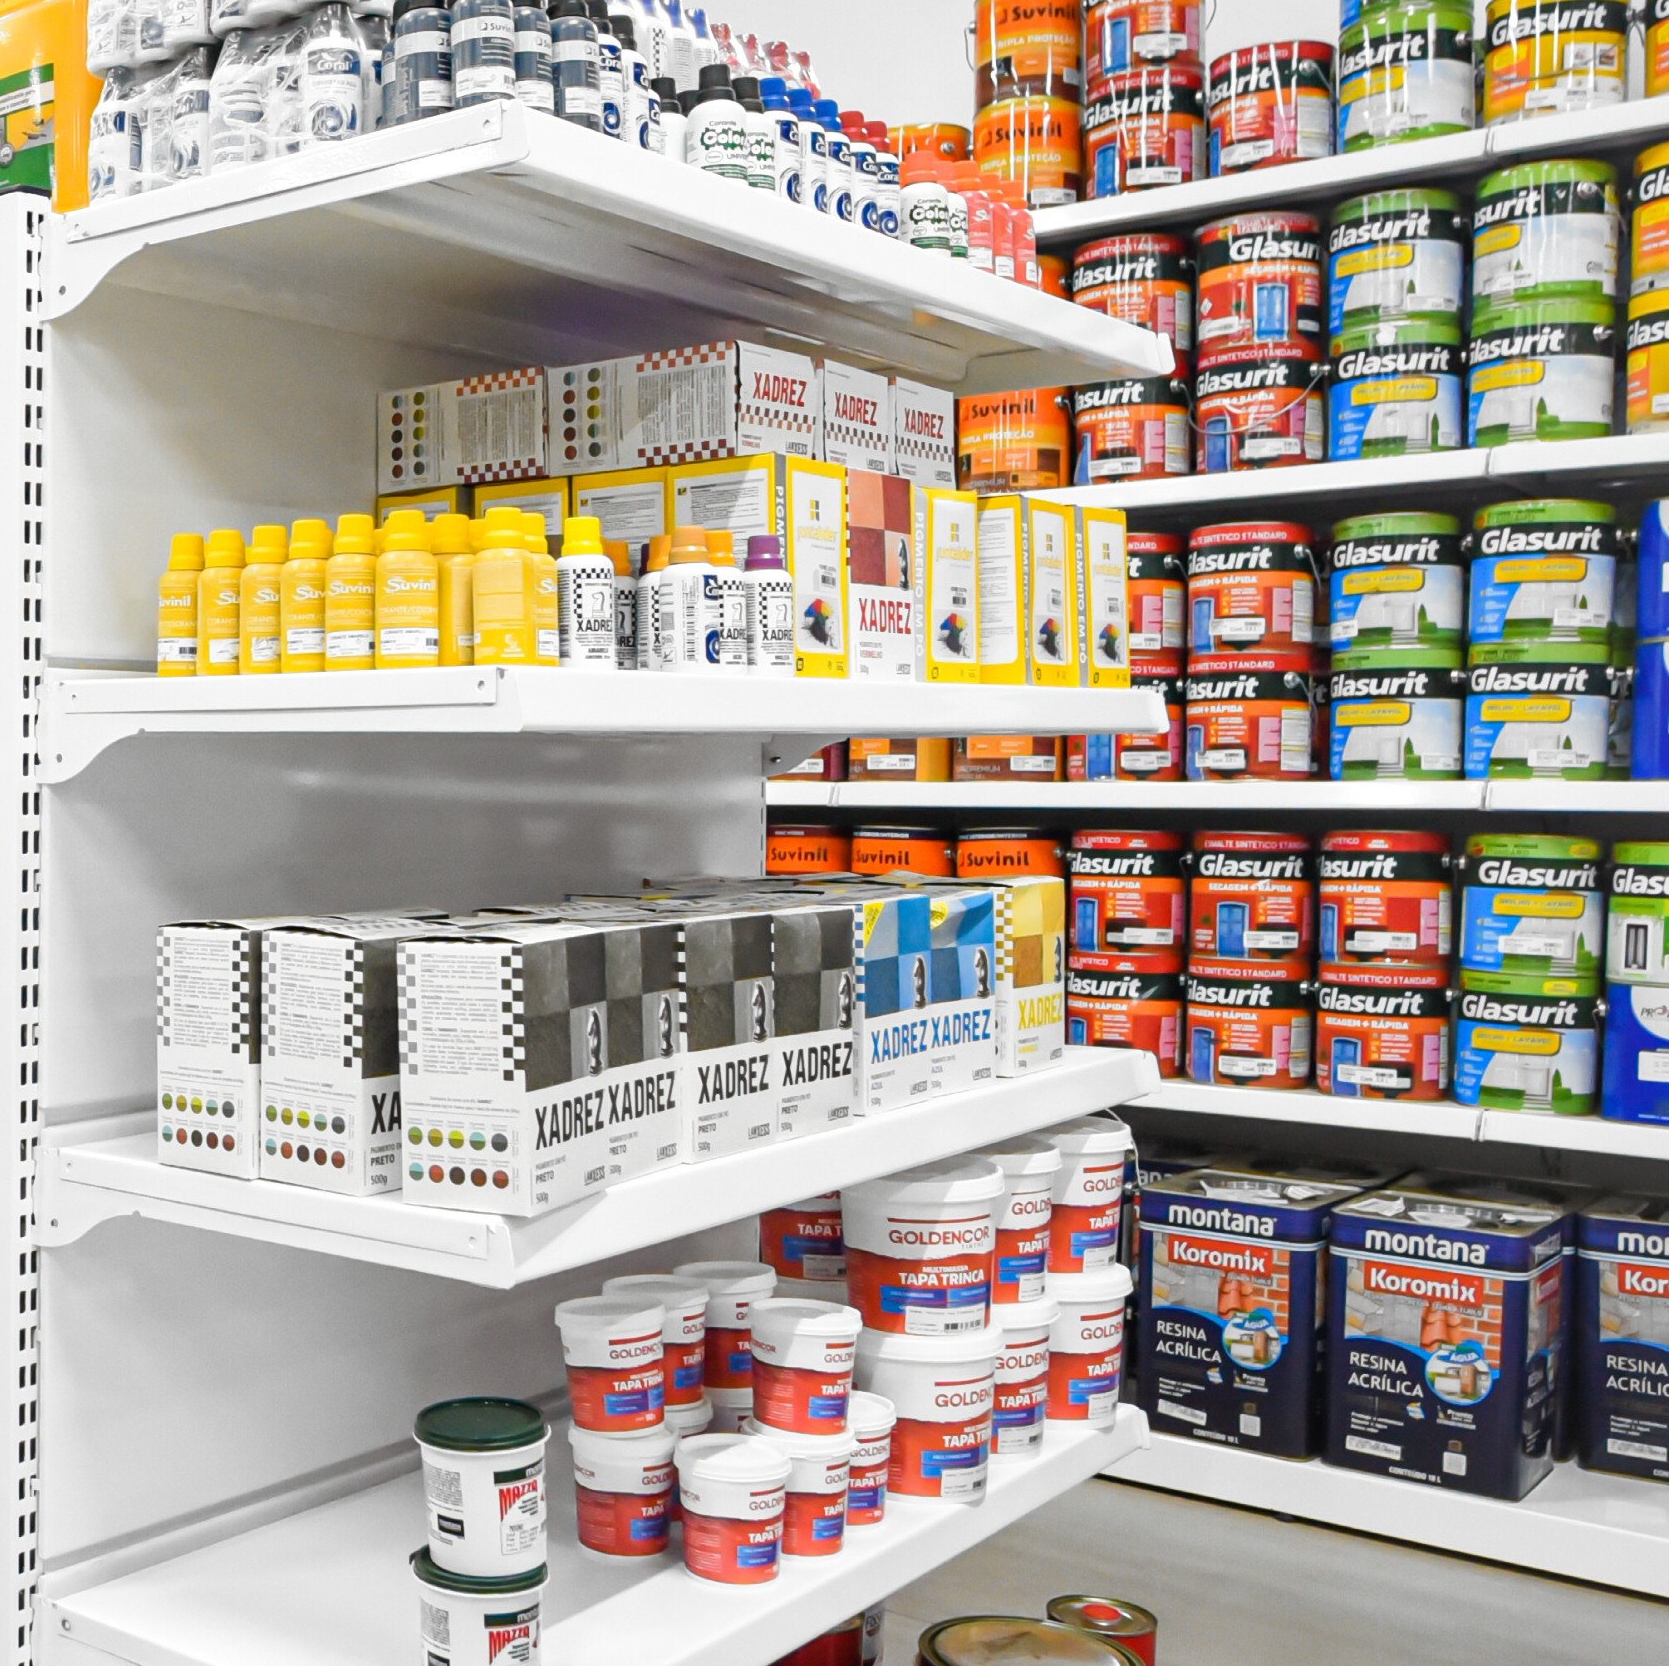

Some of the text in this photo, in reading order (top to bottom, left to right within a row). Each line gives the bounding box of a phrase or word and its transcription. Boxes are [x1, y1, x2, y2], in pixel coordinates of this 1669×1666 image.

[1012, 3, 1077, 23] Suvinil
[1492, 2, 1607, 46] Glasurit
[1330, 212, 1430, 252] Glasurit
[1338, 346, 1450, 379] Glasurit
[753, 371, 808, 408] XADREZ
[1196, 362, 1289, 397] Glasurit
[834, 391, 878, 427] XADREZ
[904, 406, 945, 440] XADREZ
[971, 398, 1036, 420] Suvinil
[1333, 536, 1440, 569] Glasurit
[1482, 525, 1602, 555] Glasurit
[859, 597, 912, 635] XADREZ
[1471, 666, 1589, 693] Glasurit
[770, 846, 829, 863] Suvinil
[857, 848, 910, 867] Suvinil
[966, 850, 1030, 867] Suvinil
[1199, 853, 1304, 879] Glasurit
[1478, 860, 1597, 888] Glasurit
[1018, 991, 1064, 1031] XADREZ
[1319, 987, 1425, 1016] Glasurit
[1462, 994, 1579, 1027] Glasurit
[871, 1019, 929, 1065] XADREZ
[931, 1008, 992, 1050] XADREZ
[697, 1053, 771, 1105] XADREZ
[782, 1041, 853, 1087] XADREZ
[608, 1070, 677, 1126] XADREZ
[535, 1088, 605, 1151] XADREZ
[370, 1153, 395, 1167] PRETO
[535, 1170, 555, 1184] PRETO
[888, 1225, 991, 1246] GOLDENCOR
[1168, 1204, 1274, 1237] montana
[1173, 1239, 1266, 1273] Koromix
[1365, 1229, 1487, 1265] montana
[898, 1269, 985, 1287] TAPA TRINCA
[1370, 1267, 1476, 1303] Koromix
[1156, 1319, 1208, 1342] RESINA
[1155, 1340, 1222, 1364] ACRÍLICA
[1350, 1351, 1408, 1375] RESINA
[1606, 1354, 1669, 1376] RESINA
[612, 1379, 641, 1393] TAPA
[1348, 1372, 1424, 1398] ACRÍLICA
[498, 1479, 539, 1524] MAZZA
[488, 1625, 530, 1666] MAZZA
